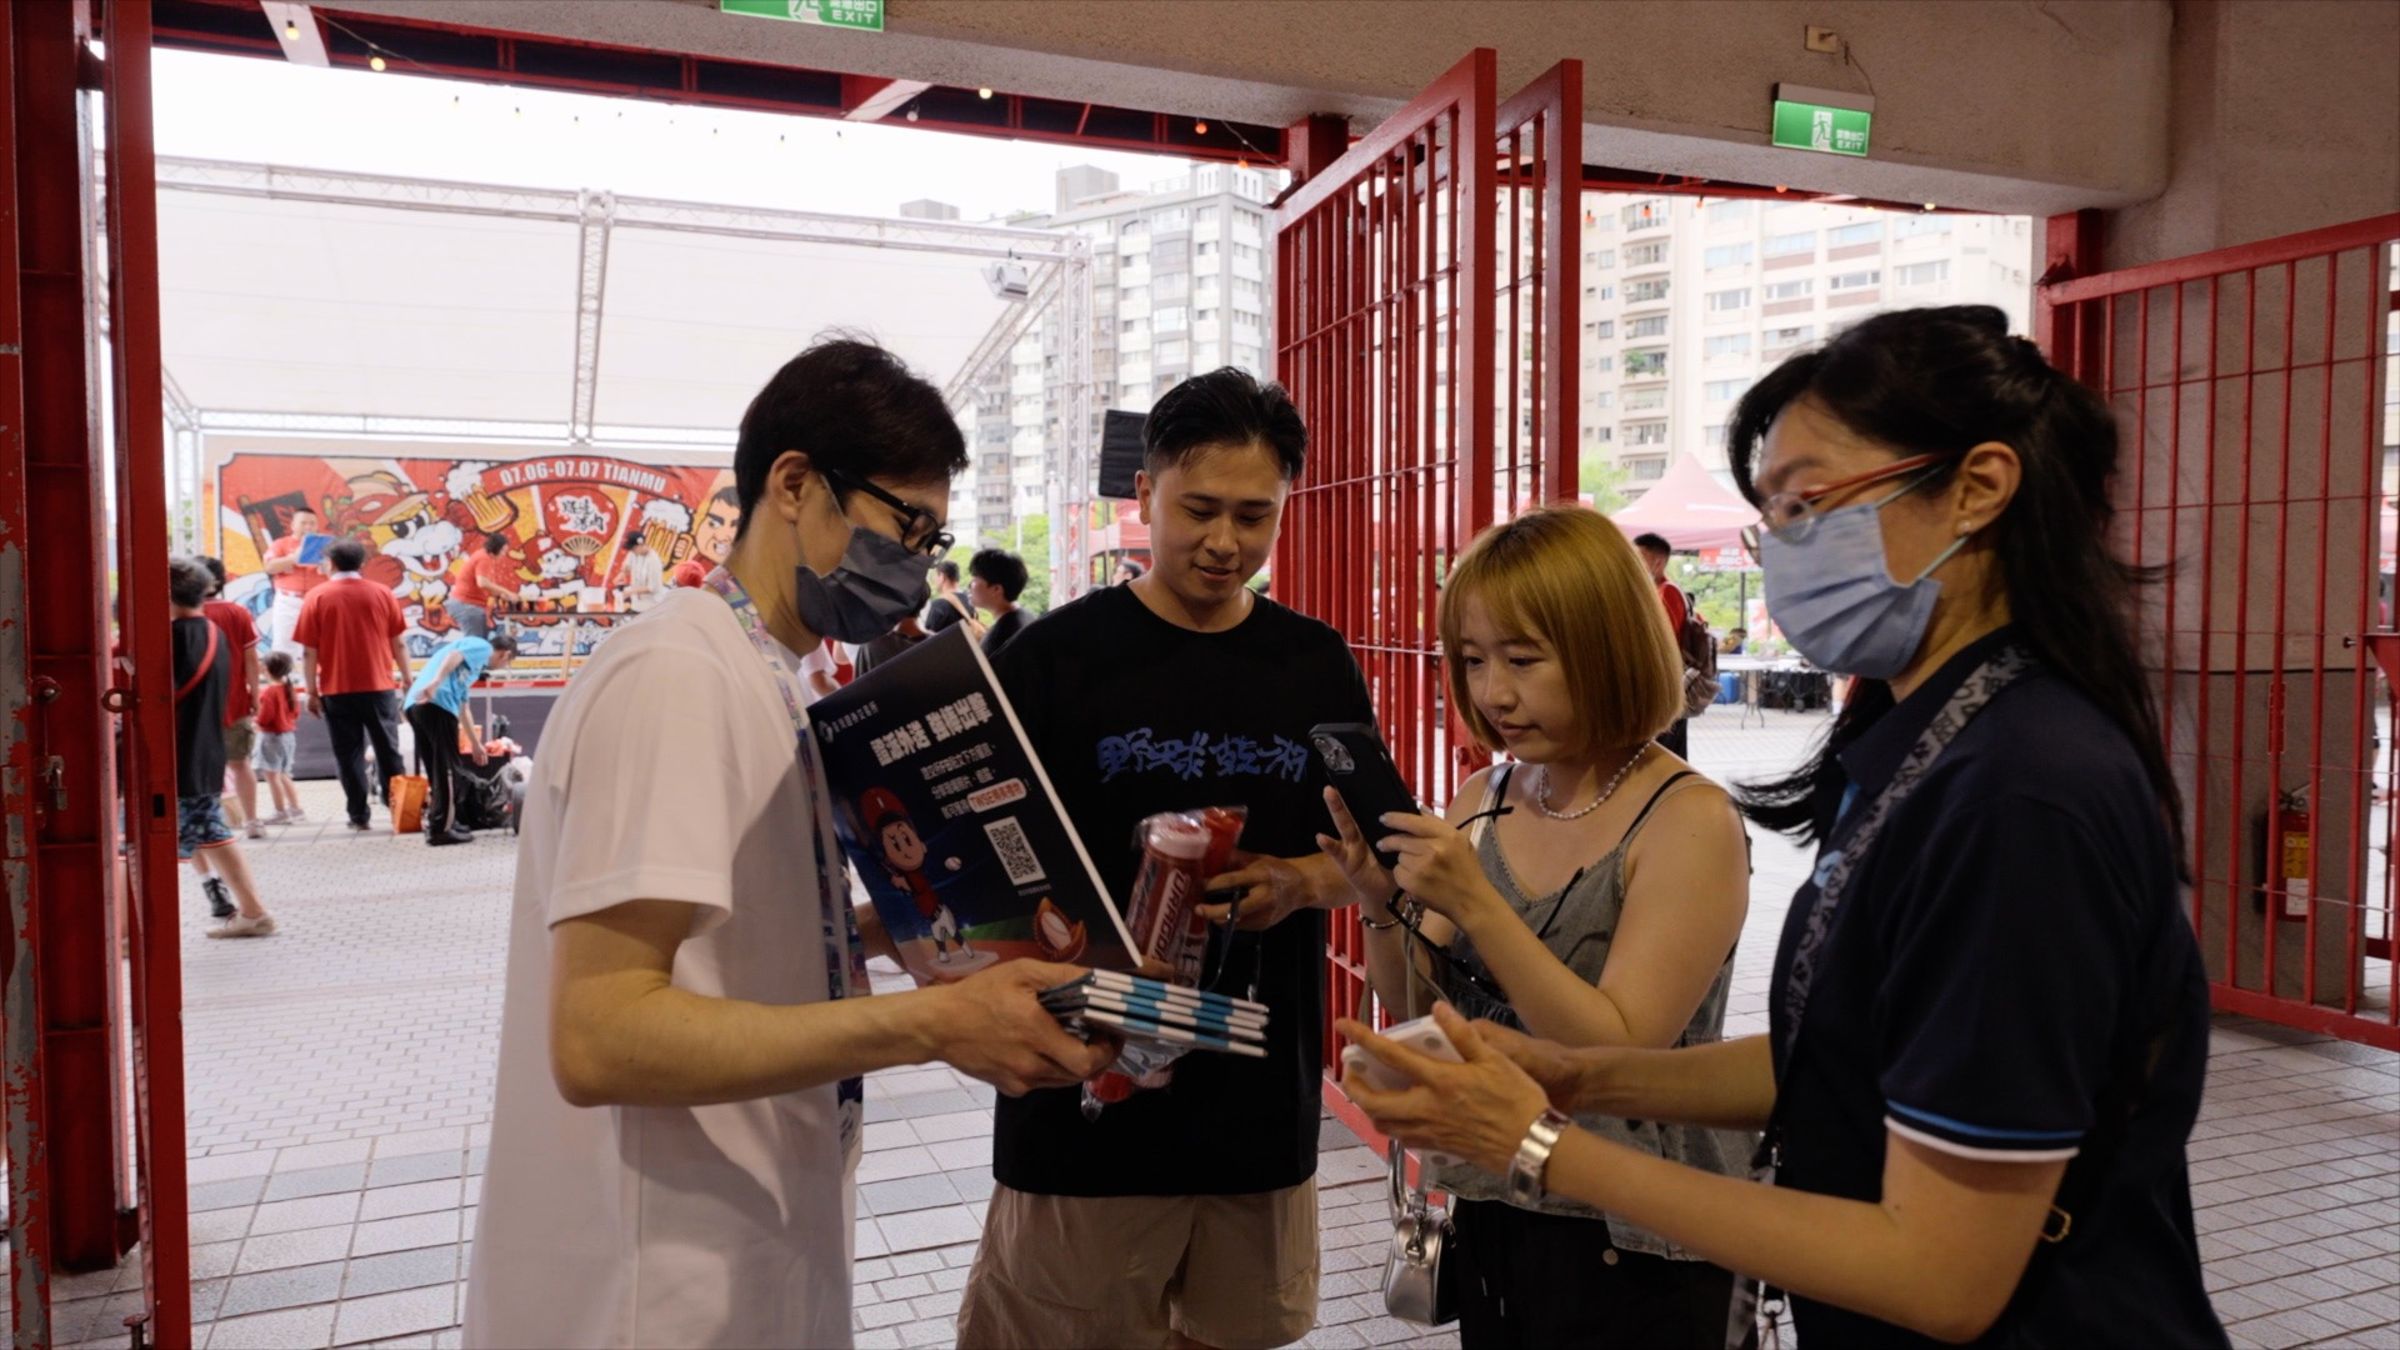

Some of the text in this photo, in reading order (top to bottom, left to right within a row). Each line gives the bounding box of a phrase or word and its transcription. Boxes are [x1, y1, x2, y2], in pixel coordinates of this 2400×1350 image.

[832, 9, 874, 24] EXIT
[499, 460, 667, 492] 07.06-07.07 TIANMU
